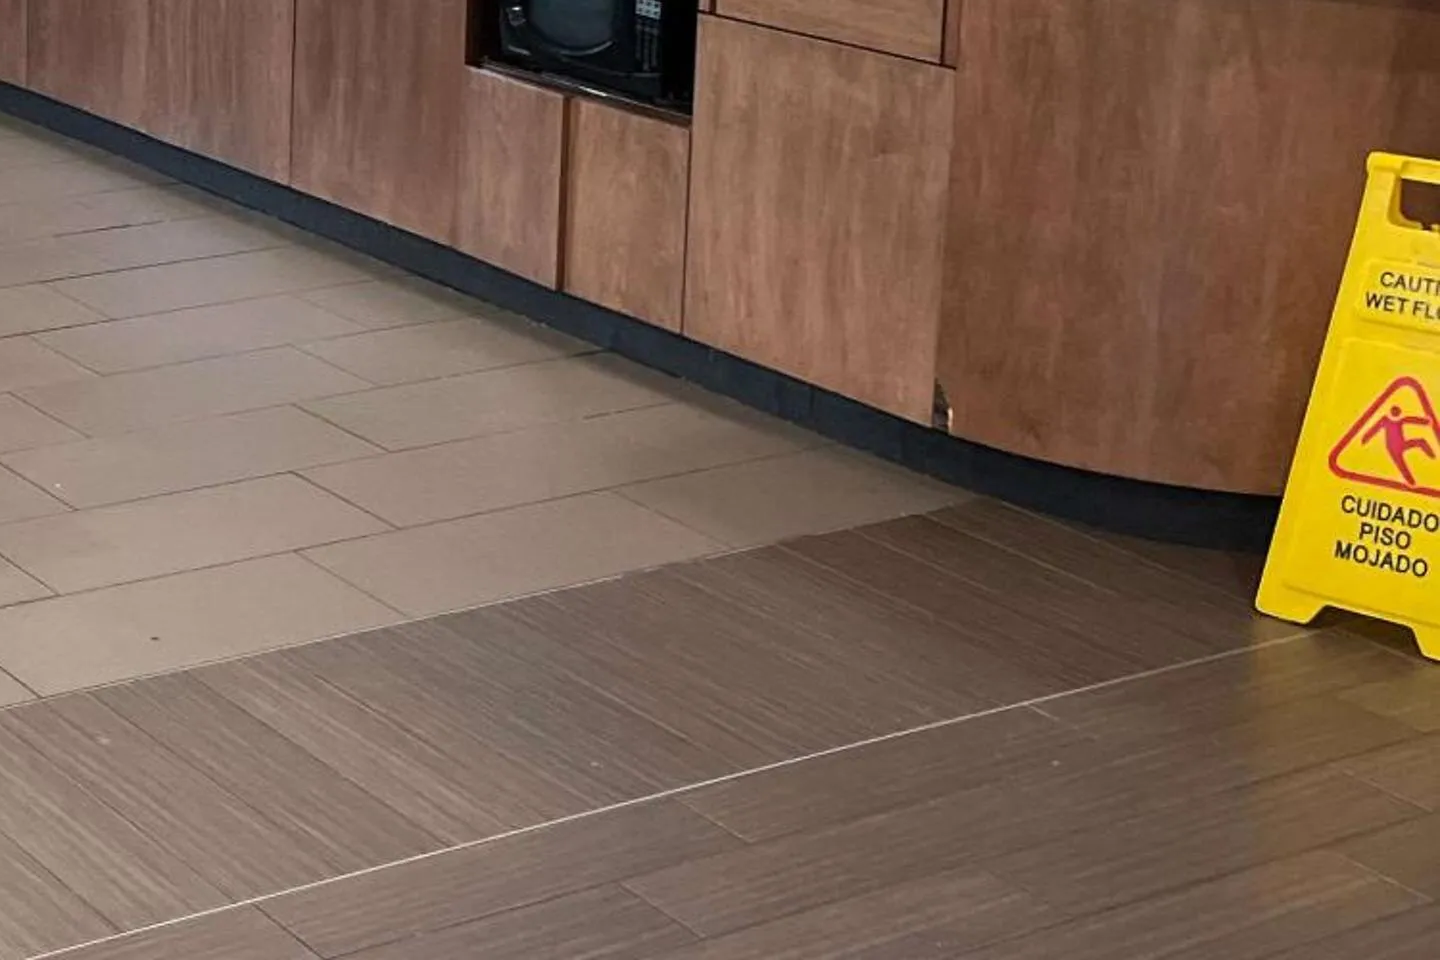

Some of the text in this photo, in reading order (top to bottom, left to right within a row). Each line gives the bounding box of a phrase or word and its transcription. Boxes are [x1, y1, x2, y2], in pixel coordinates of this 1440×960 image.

[1366, 291, 1410, 315] WET
[1341, 494, 1439, 533] CUIDADO
[1359, 521, 1411, 550] PISO
[1334, 539, 1428, 578] MOJADO
